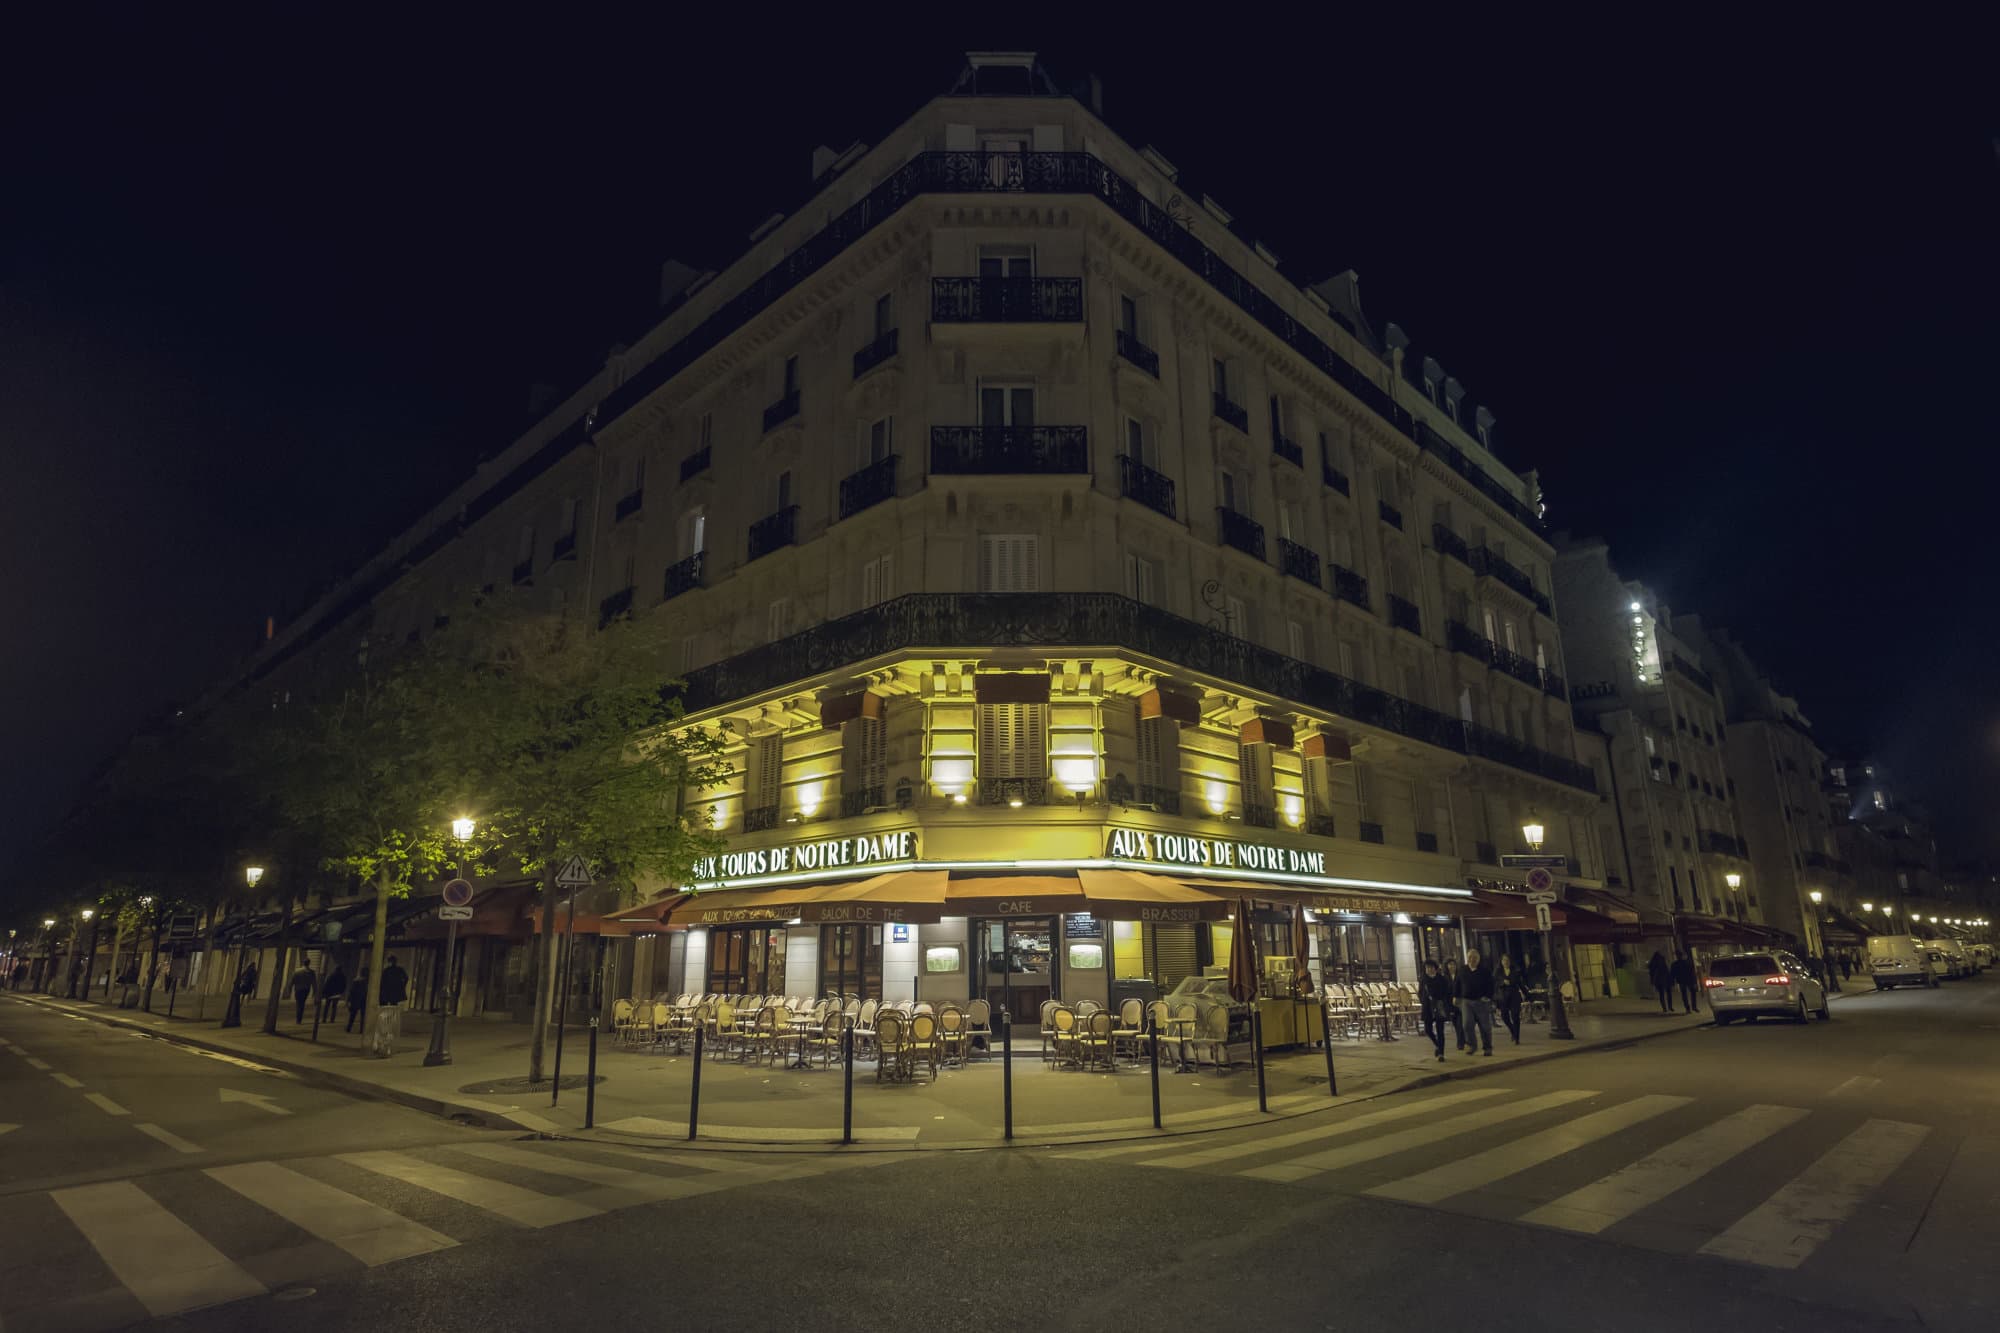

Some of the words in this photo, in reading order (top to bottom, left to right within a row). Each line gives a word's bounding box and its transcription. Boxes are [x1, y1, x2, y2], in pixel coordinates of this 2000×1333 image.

[721, 850, 766, 877] TOURS
[771, 847, 789, 872] DE
[794, 840, 849, 869] NOTRE
[857, 832, 911, 862] DAME
[1112, 830, 1148, 857] AUX
[1154, 834, 1209, 864] TOURS
[1214, 841, 1233, 866] DE
[1238, 844, 1286, 871] NOTRE
[1290, 849, 1326, 874] DAME
[821, 907, 849, 920] SALON
[856, 907, 872, 919] DE
[882, 908, 904, 920] THE
[998, 901, 1032, 913] CAFE
[1142, 907, 1200, 920] BRASSER
[702, 911, 719, 922] AUX
